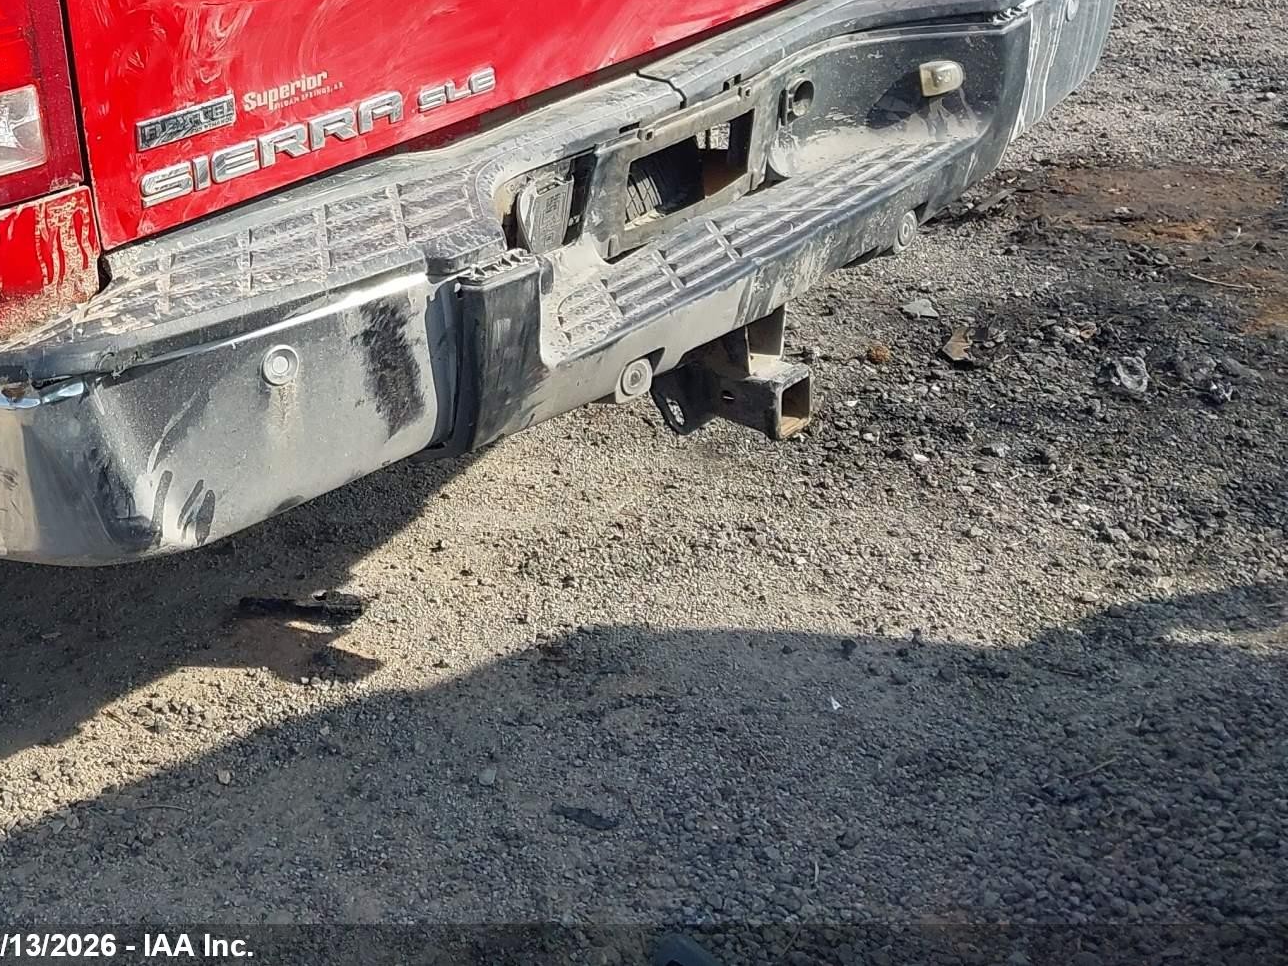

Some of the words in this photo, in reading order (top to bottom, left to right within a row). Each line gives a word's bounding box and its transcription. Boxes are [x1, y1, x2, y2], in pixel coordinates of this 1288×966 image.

[140, 90, 404, 209] SIERRA
[418, 66, 496, 113] SLE
[242, 71, 329, 112] Superior
